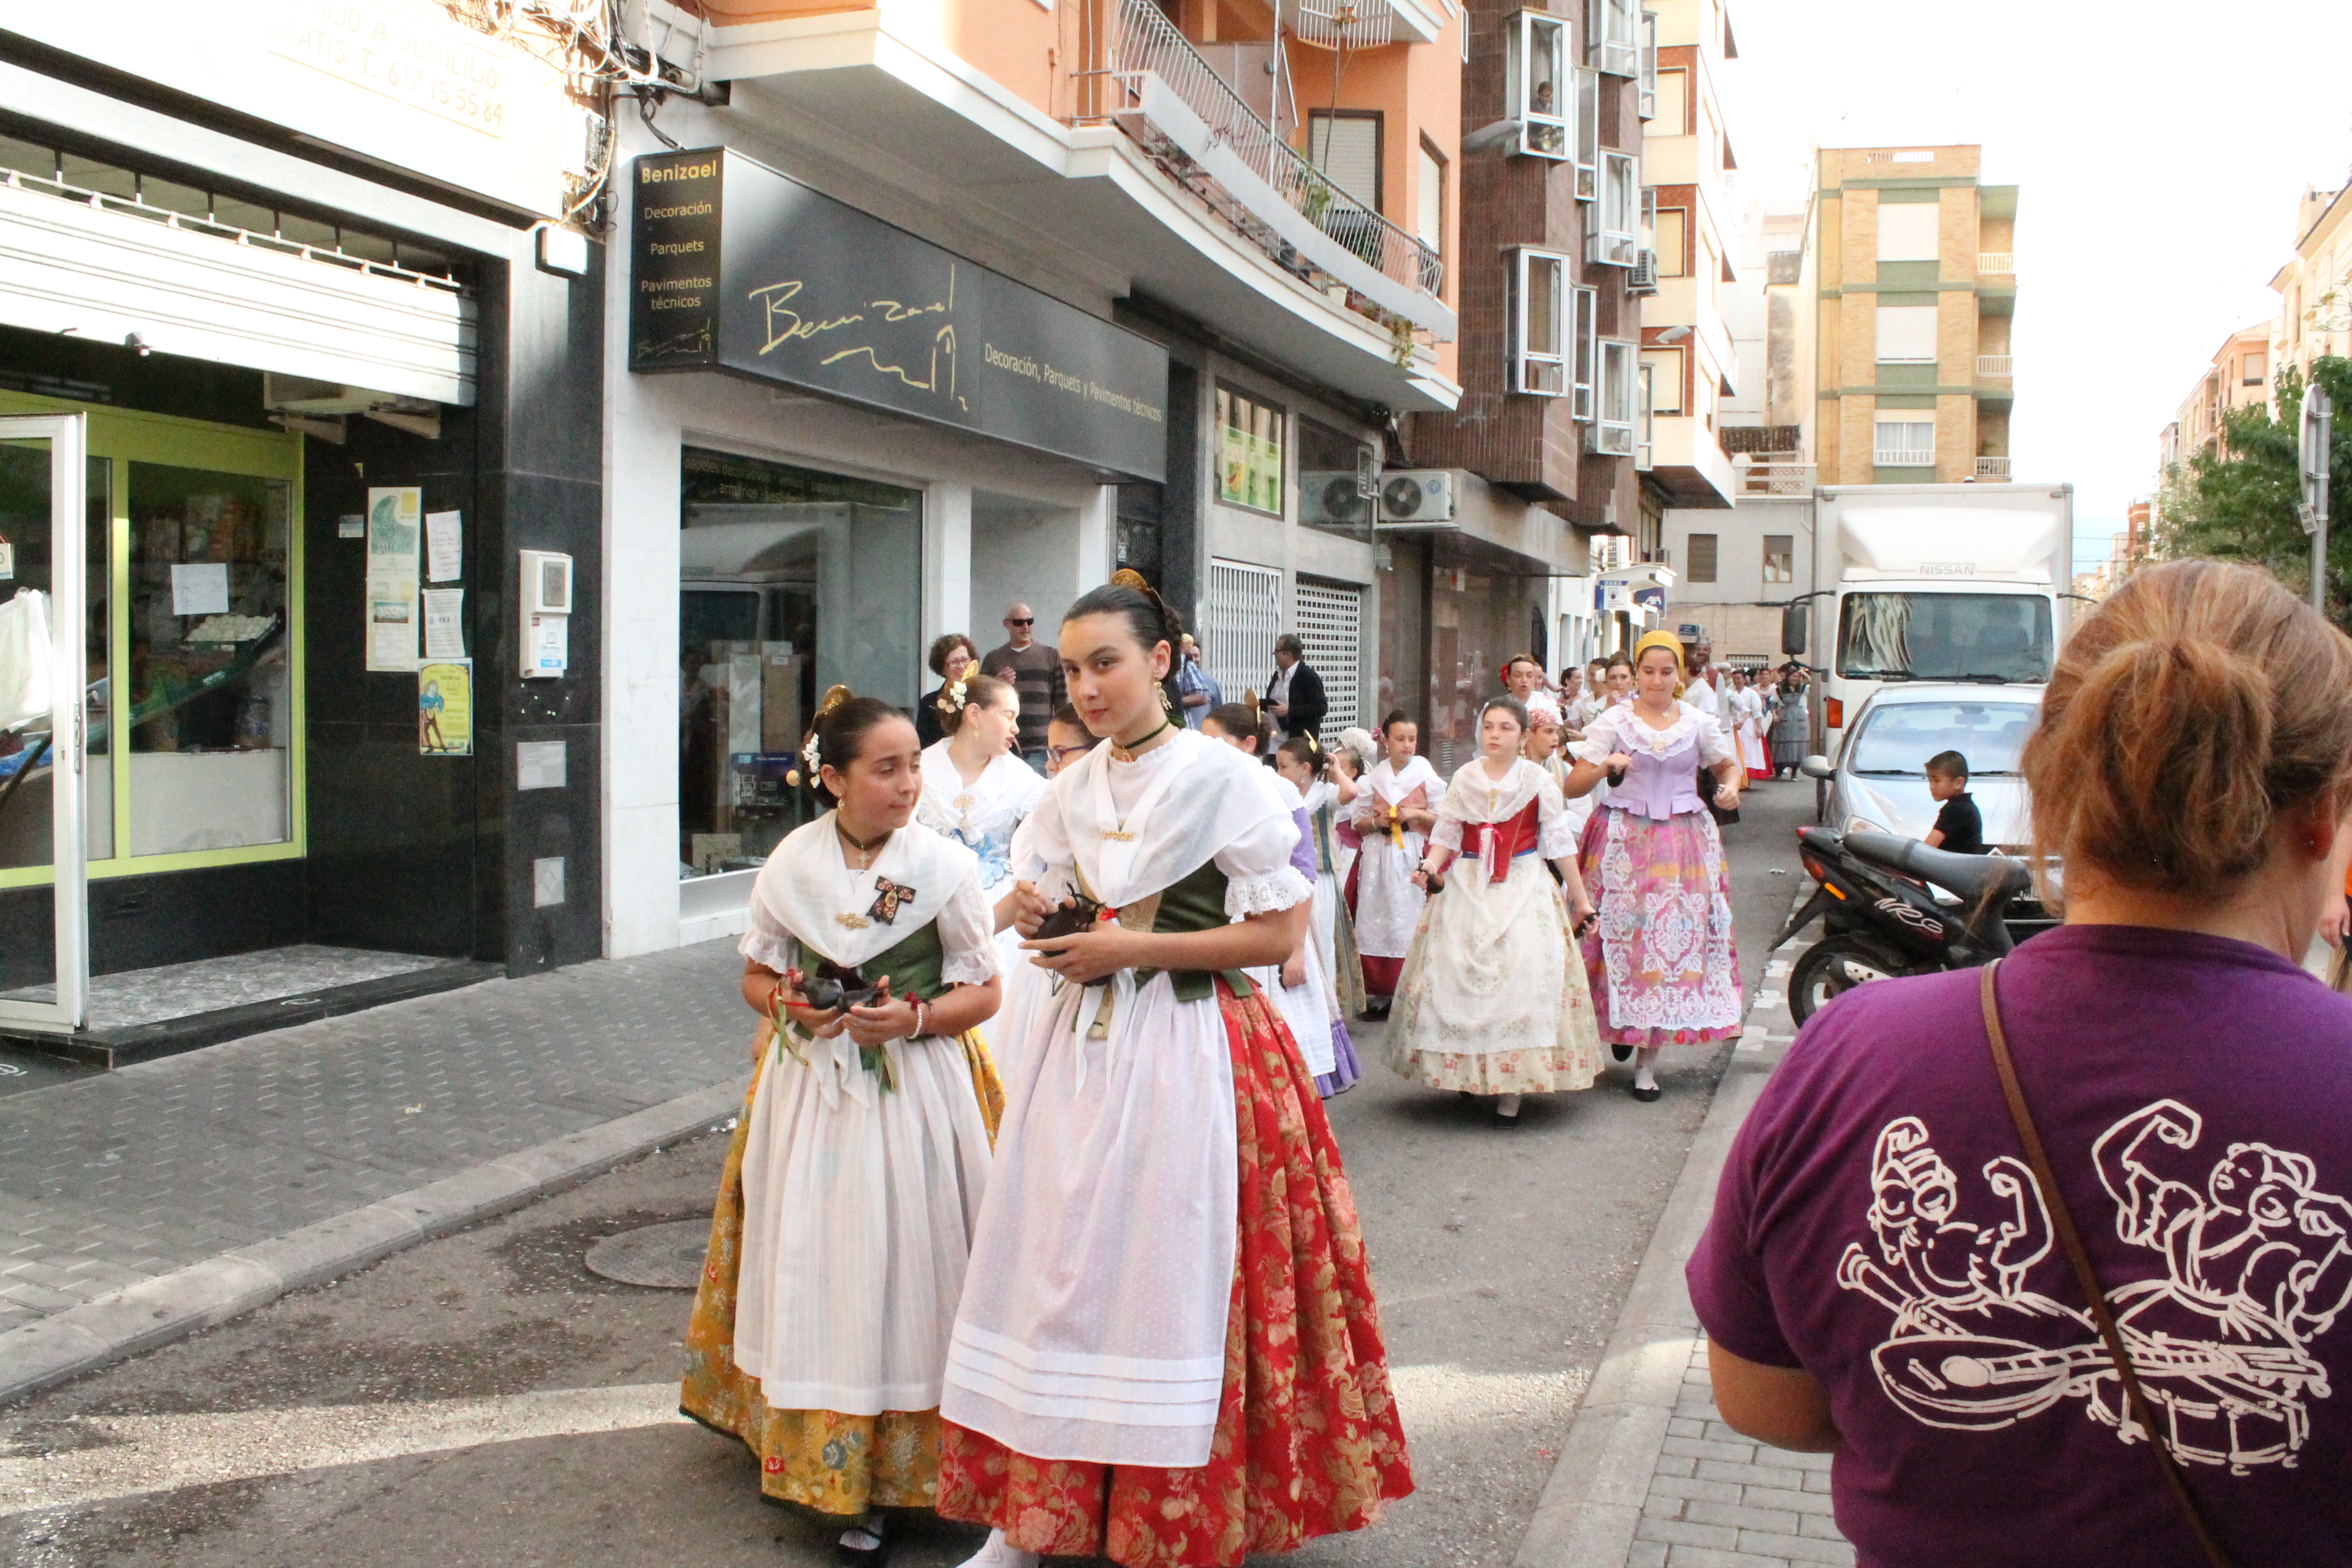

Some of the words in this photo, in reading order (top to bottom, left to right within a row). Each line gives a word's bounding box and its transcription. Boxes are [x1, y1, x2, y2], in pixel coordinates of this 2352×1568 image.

[266, 17, 346, 64] GRATIS
[388, 62, 423, 93] 617
[372, 19, 388, 45] A
[401, 29, 498, 90] DOMICILIO
[642, 160, 716, 183] Benizael
[645, 200, 712, 219] Decoración
[651, 240, 704, 255] Parquets
[641, 277, 712, 292] Pavimentos
[651, 296, 701, 309] técnicos
[985, 343, 1041, 383] Decoración,
[1044, 364, 1081, 393] Parquets
[1083, 383, 1088, 400] y
[1090, 381, 1131, 412] Pavimentos
[1133, 398, 1162, 422] técnicos
[1119, 545, 1126, 559] 26
[1920, 565, 1974, 575] NISSAN
